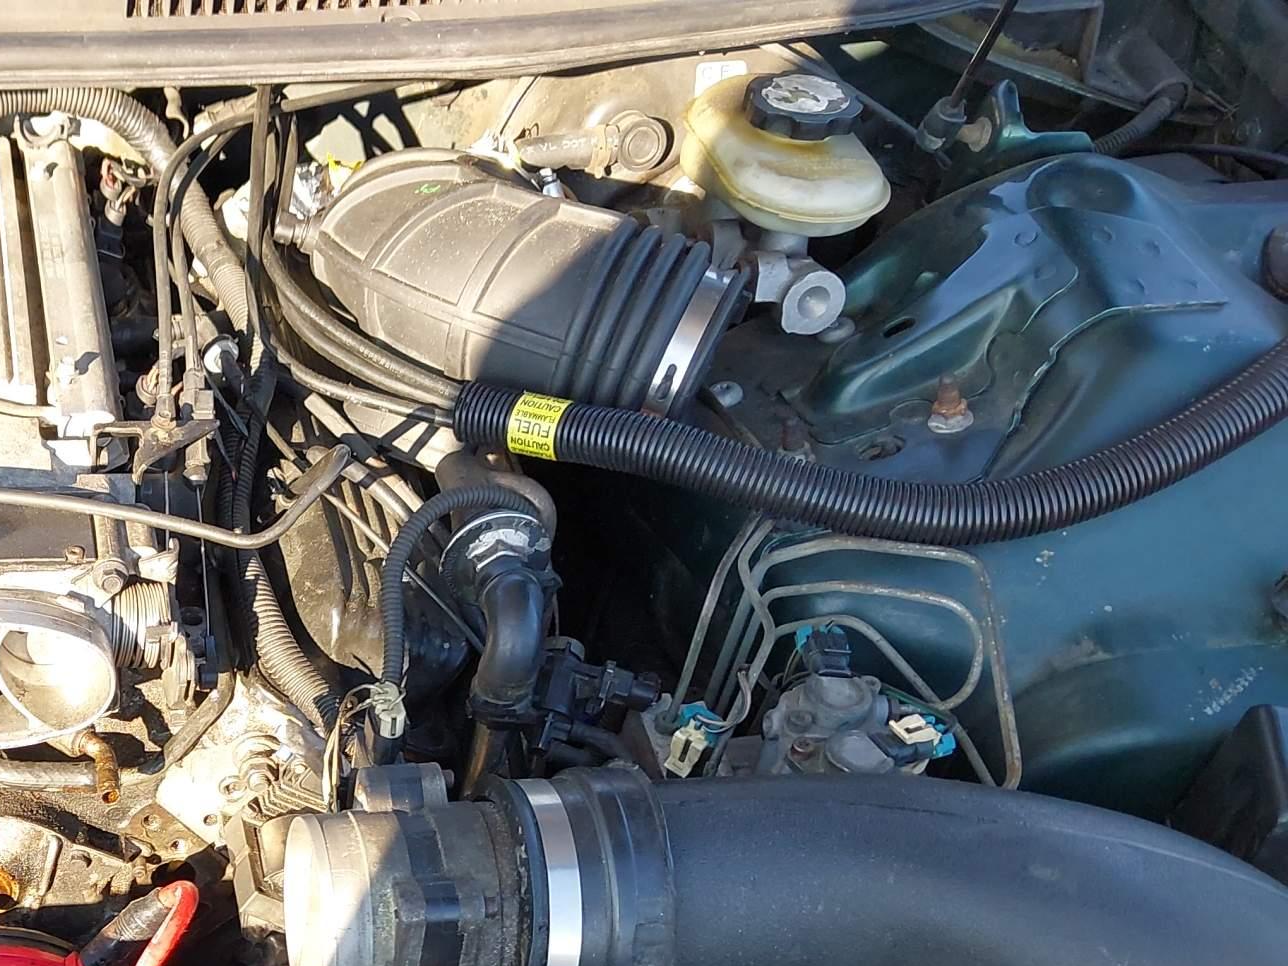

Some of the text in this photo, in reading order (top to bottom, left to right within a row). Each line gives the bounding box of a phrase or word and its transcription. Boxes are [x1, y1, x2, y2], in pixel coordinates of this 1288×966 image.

[520, 399, 561, 413] CAUTION
[515, 409, 556, 423] FLAMMABLE
[514, 418, 551, 438] FUEL
[511, 436, 550, 451] CAUTION
